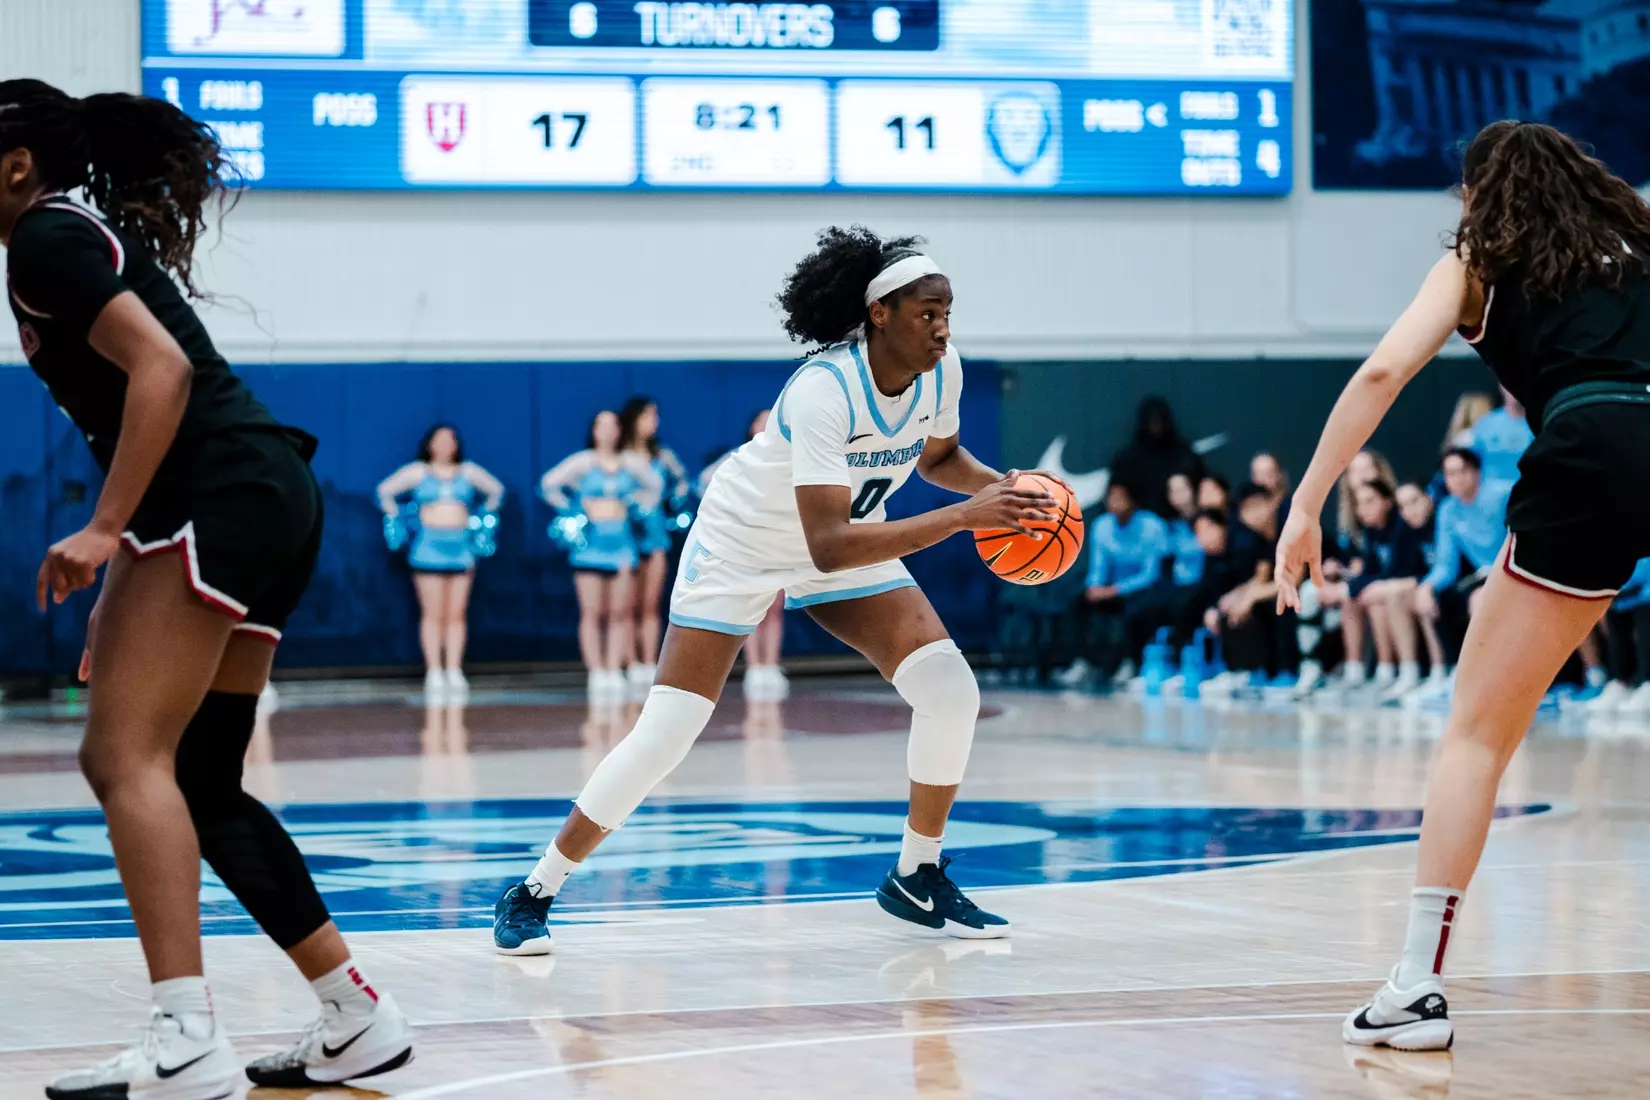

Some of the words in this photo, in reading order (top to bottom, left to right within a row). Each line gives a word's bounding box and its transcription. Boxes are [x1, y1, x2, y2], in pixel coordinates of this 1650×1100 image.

[634, 2, 834, 48] TURNOVERS
[694, 103, 784, 132] 8:21
[1257, 88, 1279, 127] 1
[531, 112, 590, 149] 17
[885, 115, 934, 150] 11
[845, 438, 925, 468] OLUMBIA
[850, 477, 892, 519] 0
